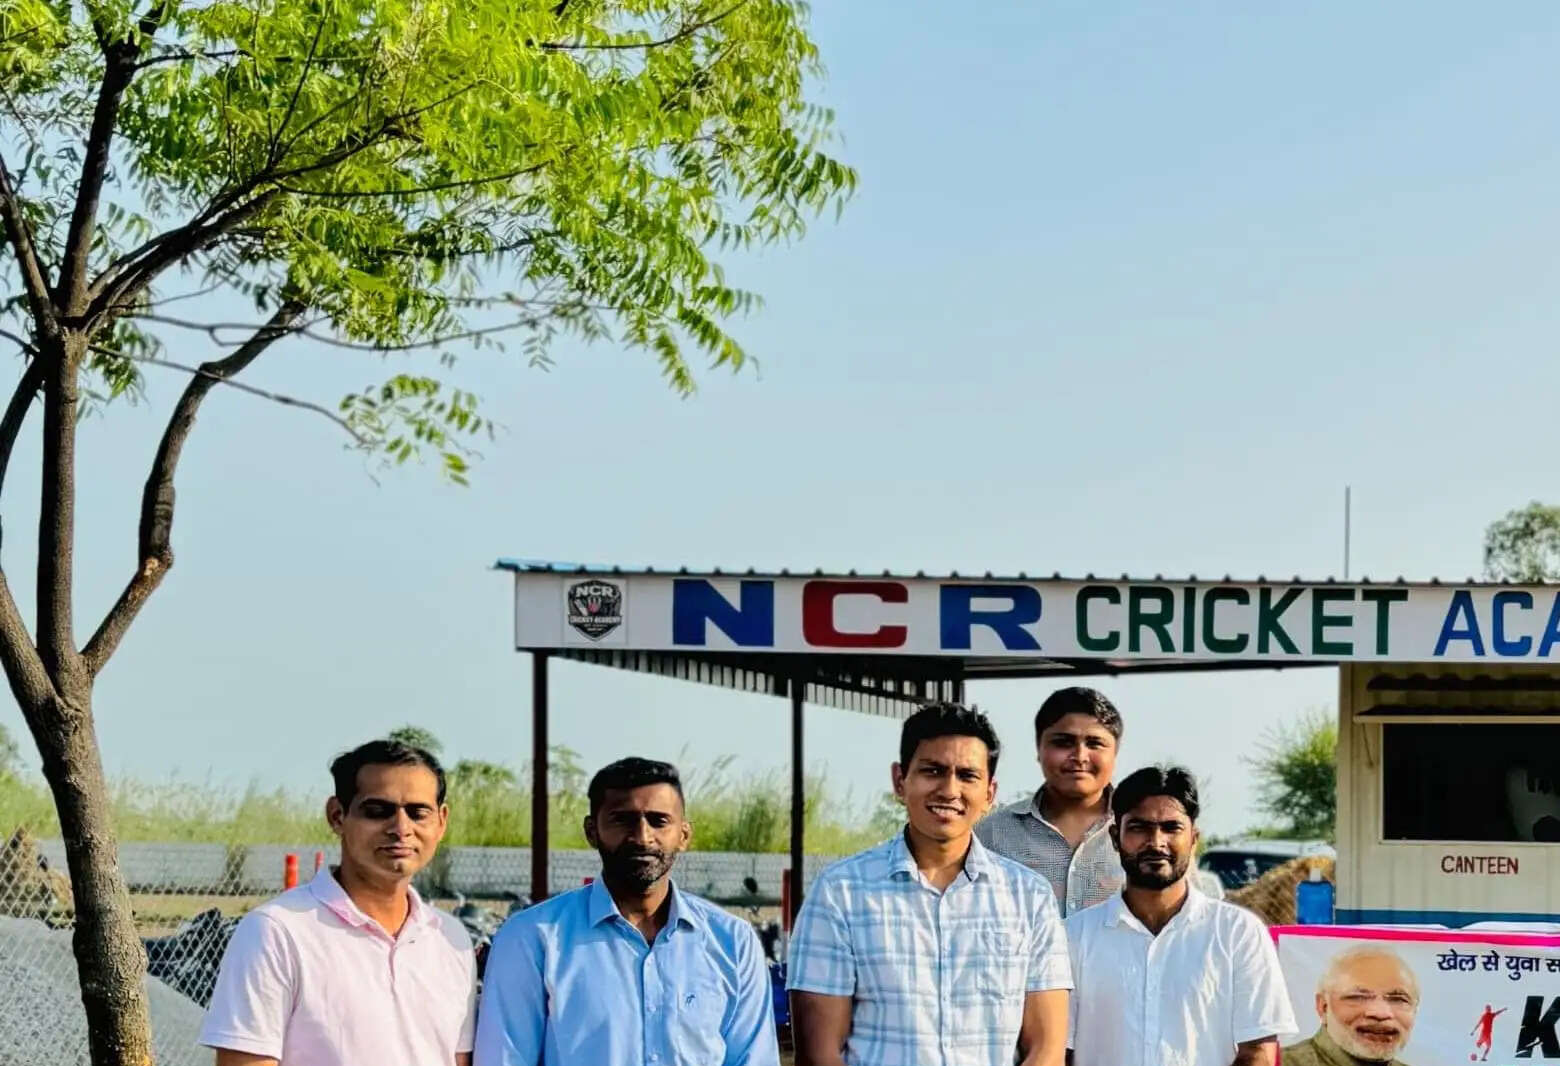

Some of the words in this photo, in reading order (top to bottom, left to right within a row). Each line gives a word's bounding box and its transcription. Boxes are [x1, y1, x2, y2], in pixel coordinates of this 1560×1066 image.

[576, 585, 614, 598] NCR
[672, 578, 1042, 650] NCR
[1075, 585, 1409, 656] CRICKET
[1441, 855, 1519, 874] CANTEEN
[1437, 949, 1478, 971] खेल
[1482, 950, 1499, 971] से
[1505, 955, 1540, 980] युवा
